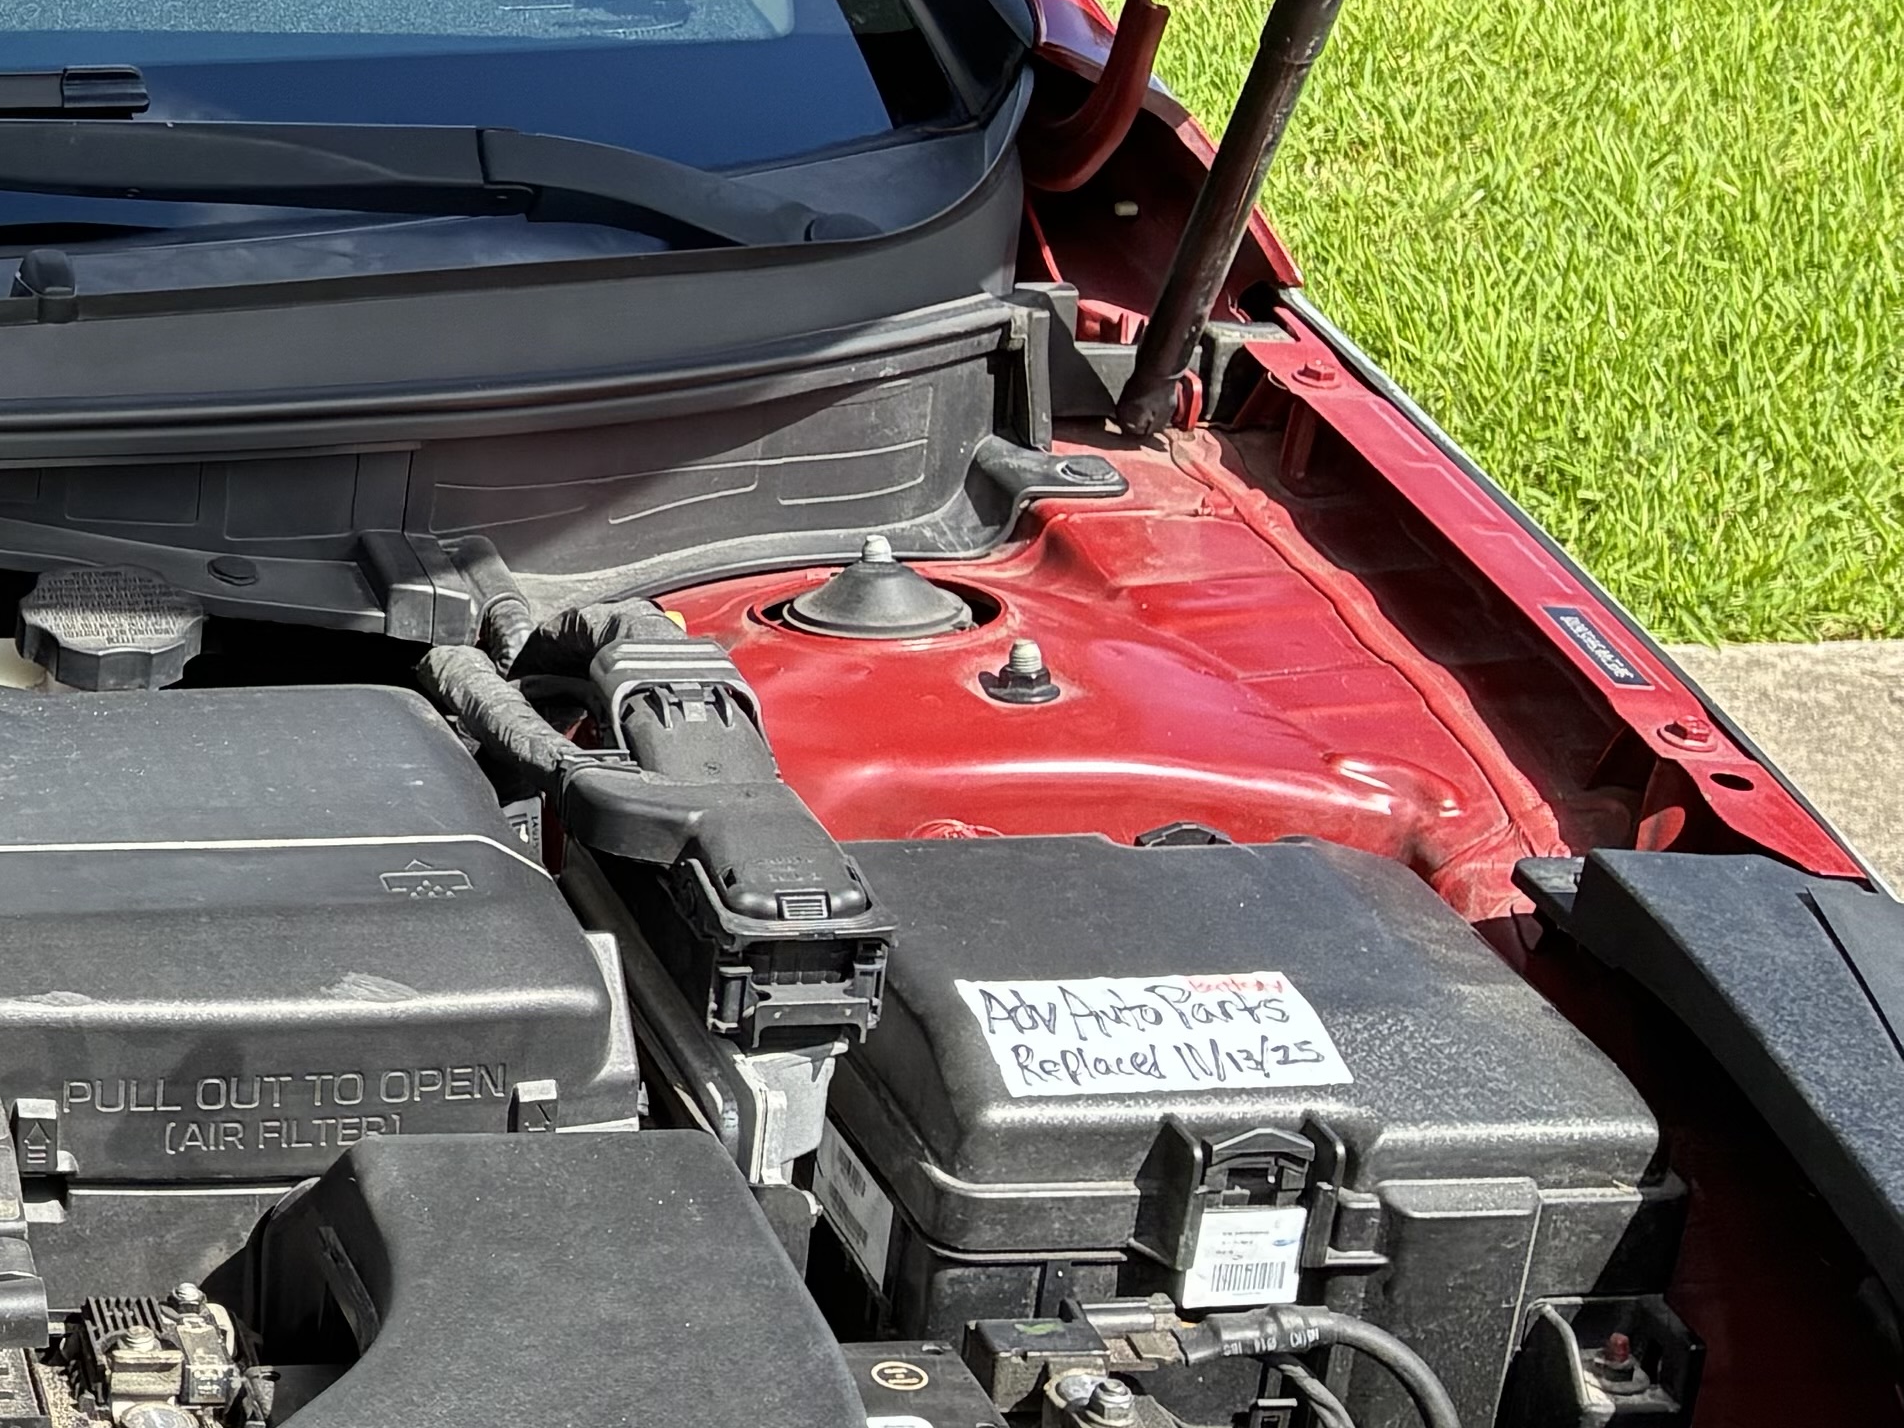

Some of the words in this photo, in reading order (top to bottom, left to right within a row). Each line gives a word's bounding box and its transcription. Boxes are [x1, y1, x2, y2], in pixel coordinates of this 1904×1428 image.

[978, 988, 1057, 1035] Adv
[1058, 985, 1163, 1040] Auto
[1144, 984, 1291, 1029] Parts
[1010, 1043, 1167, 1085] Replaced
[61, 1077, 182, 1113] PULL
[195, 1074, 291, 1111] OUT
[304, 1071, 365, 1107] TO
[379, 1063, 507, 1103] OPEN
[165, 1117, 245, 1156] (AIR
[258, 1114, 402, 1149] FILTER)
